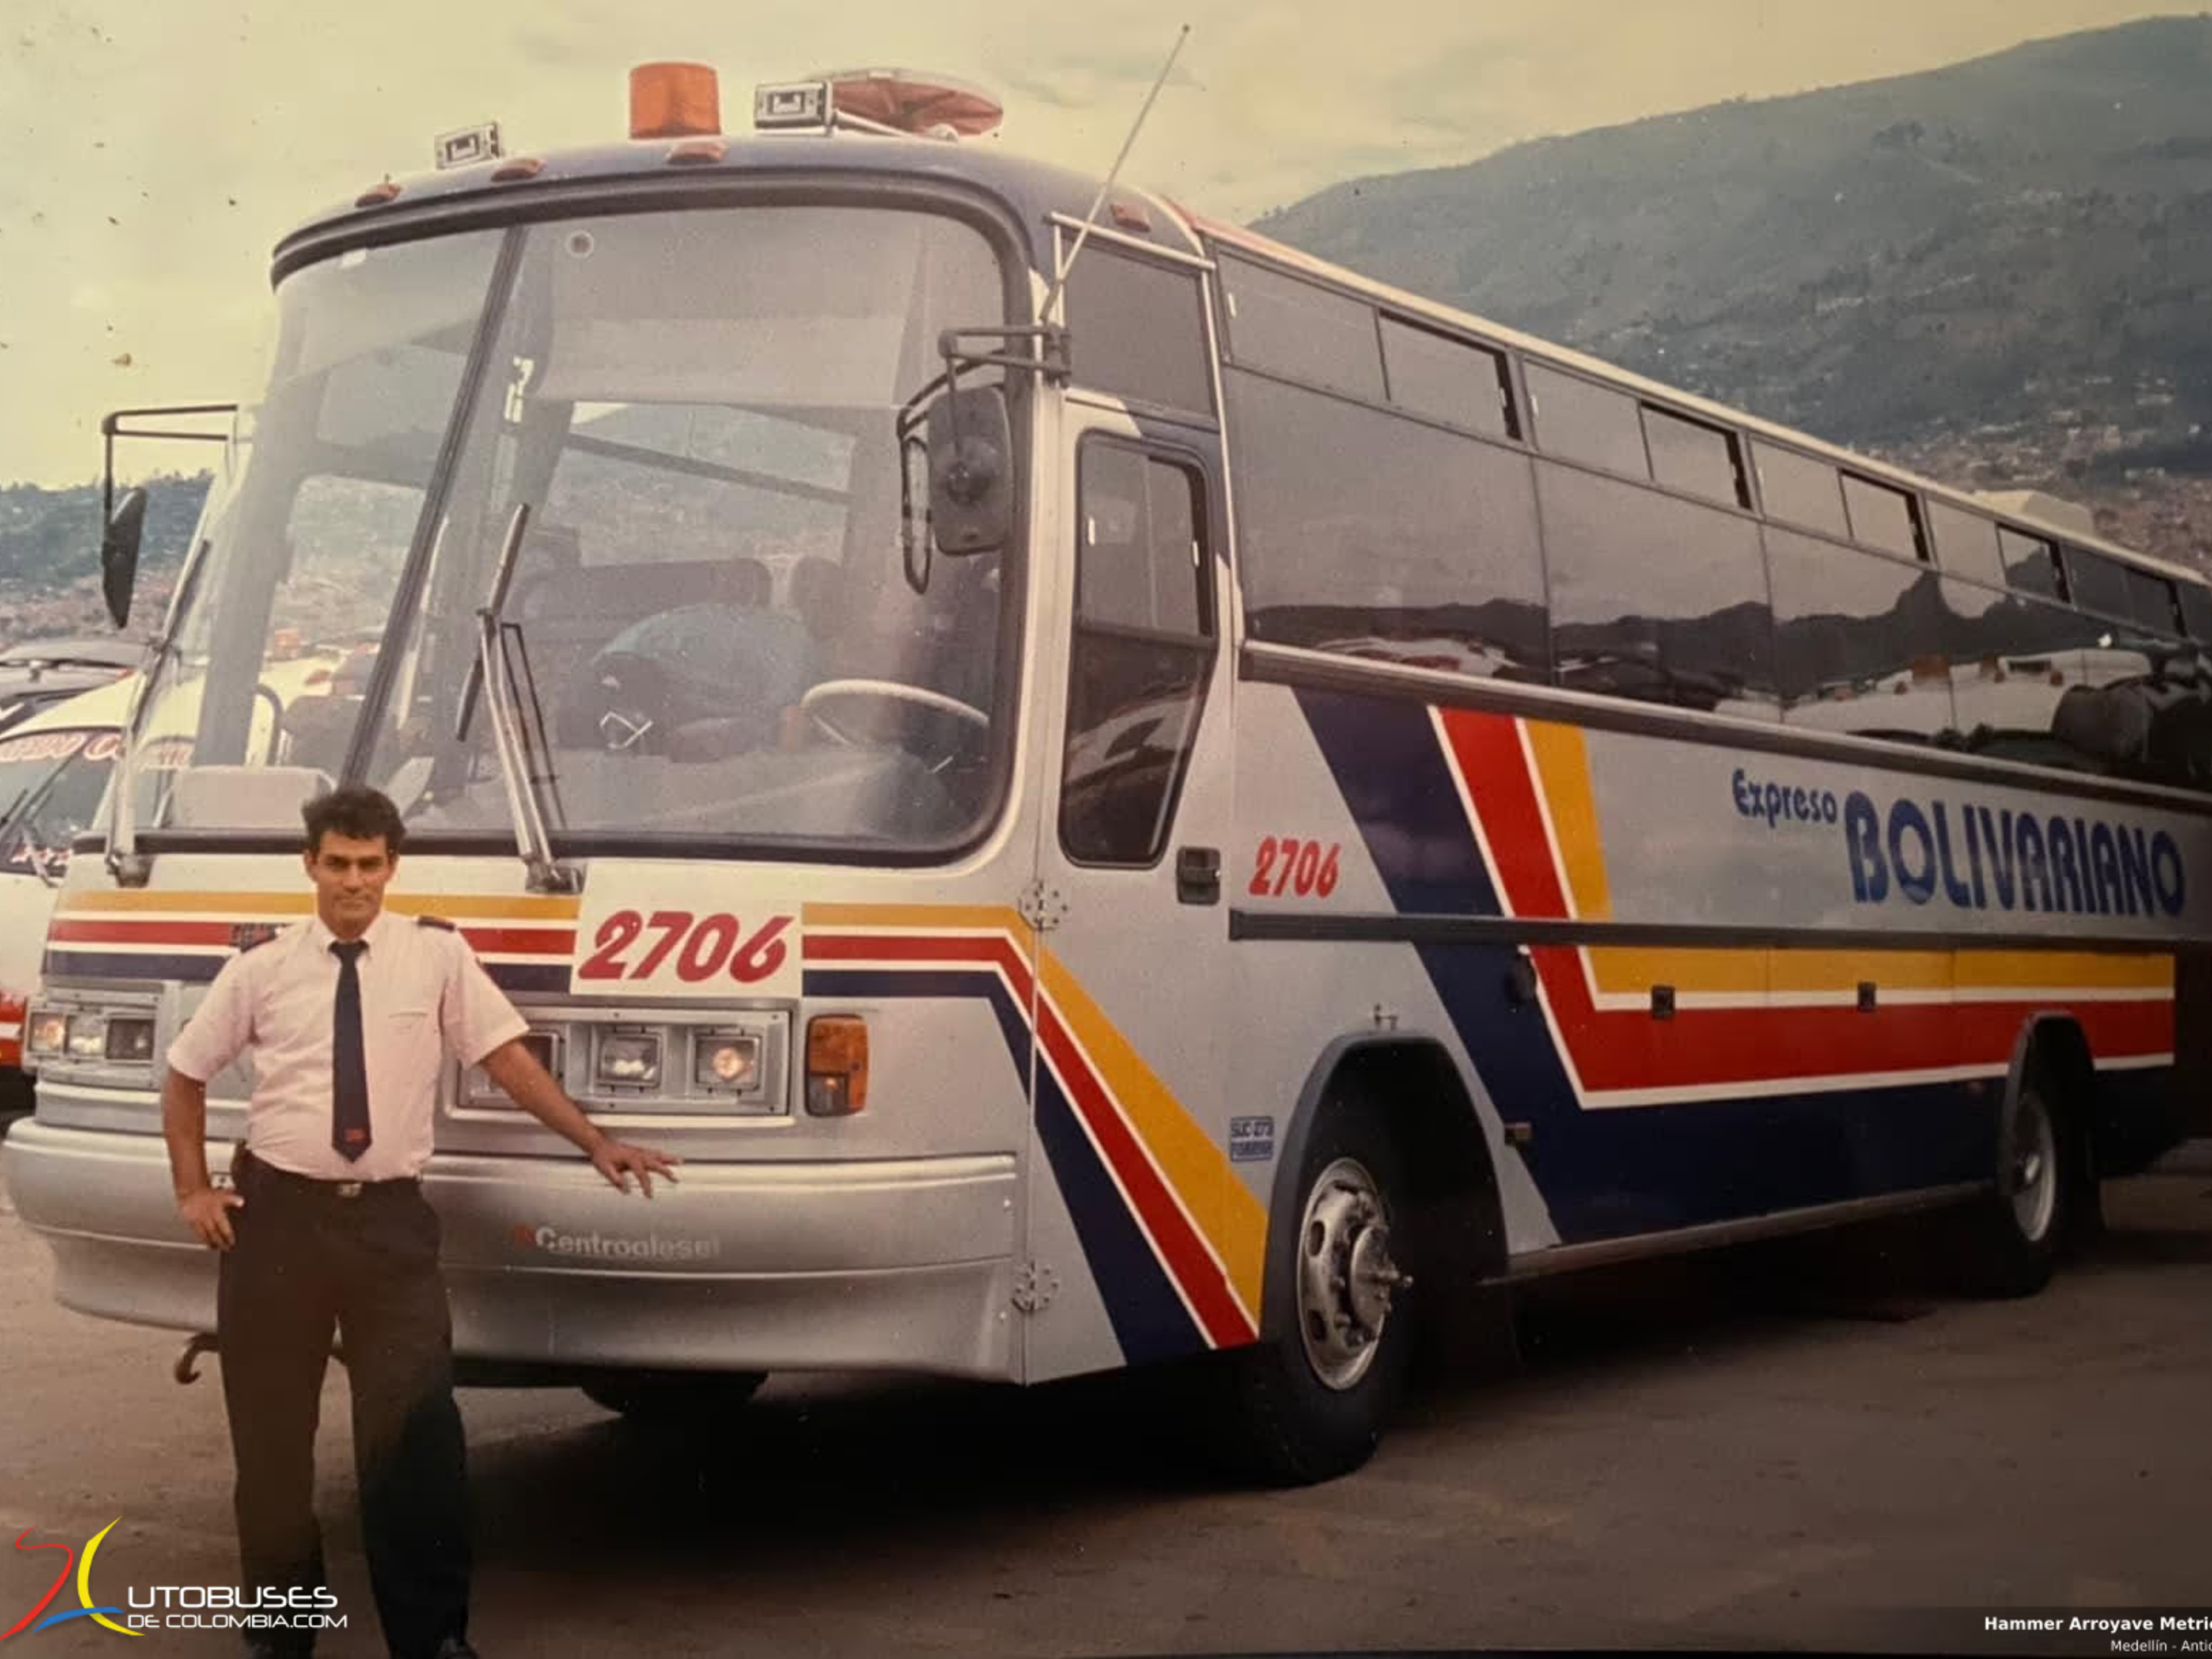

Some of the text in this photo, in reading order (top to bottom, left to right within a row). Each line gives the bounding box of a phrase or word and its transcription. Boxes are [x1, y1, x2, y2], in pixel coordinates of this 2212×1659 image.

[1732, 768, 1838, 828] Expreso
[1248, 835, 1341, 899] 2706
[1844, 790, 2186, 918] BOLIVARIANO
[577, 909, 795, 983] 2706
